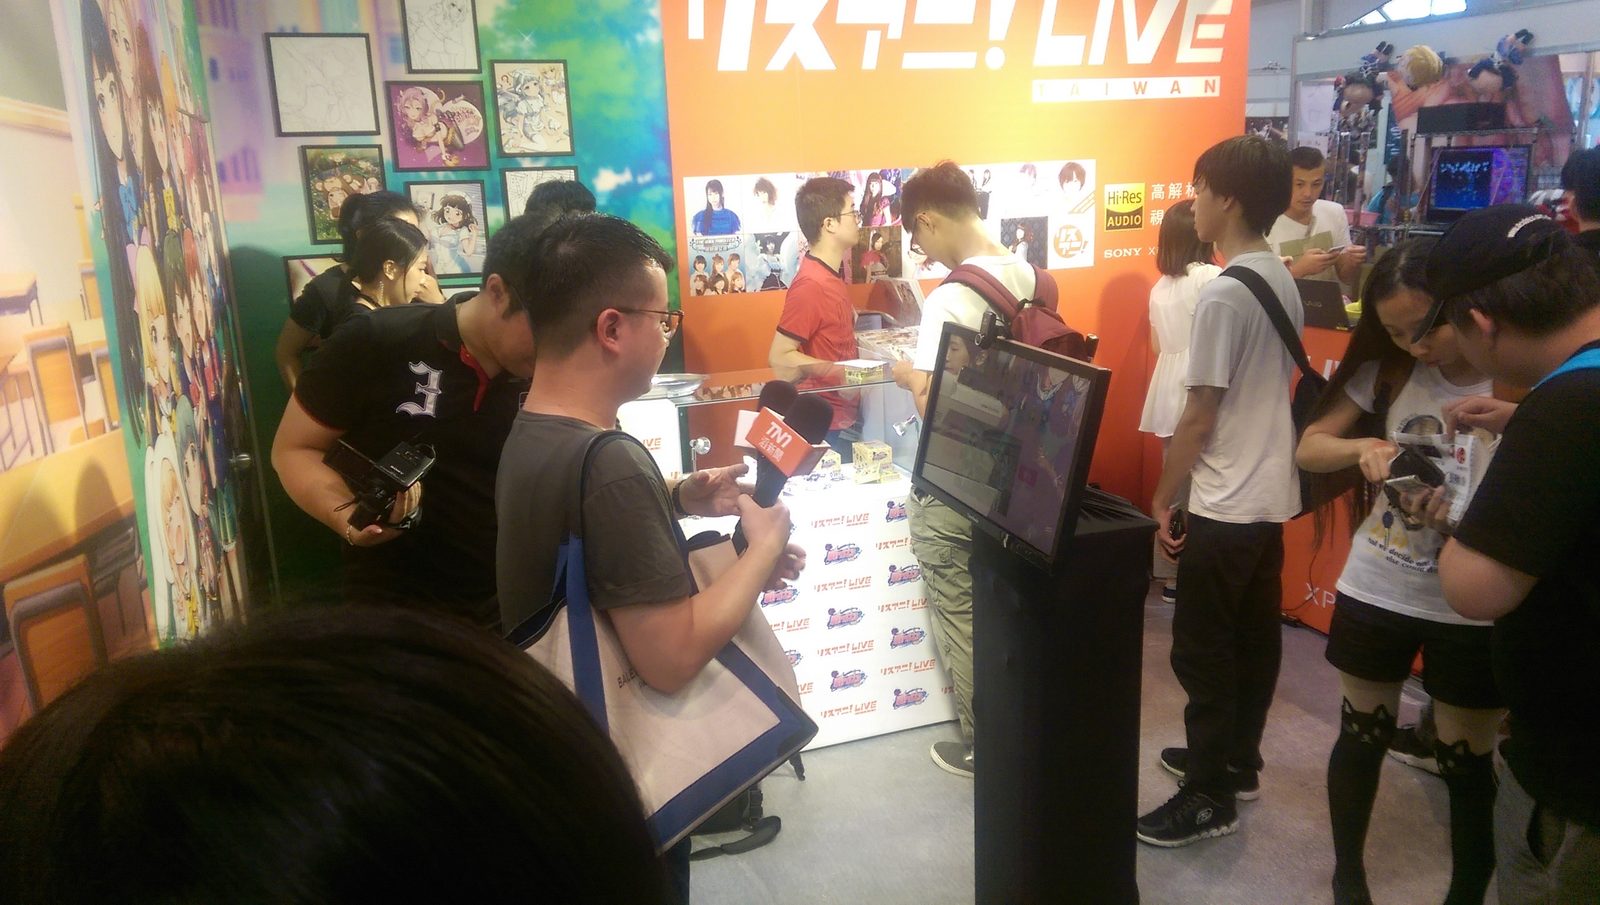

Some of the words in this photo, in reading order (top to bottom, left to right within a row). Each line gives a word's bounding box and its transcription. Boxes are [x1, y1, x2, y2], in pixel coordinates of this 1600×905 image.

[1033, 0, 1232, 67] LIVE
[1038, 79, 1216, 97] TAIWAN
[1107, 214, 1142, 227] AUDIO
[1103, 247, 1142, 259] SONY
